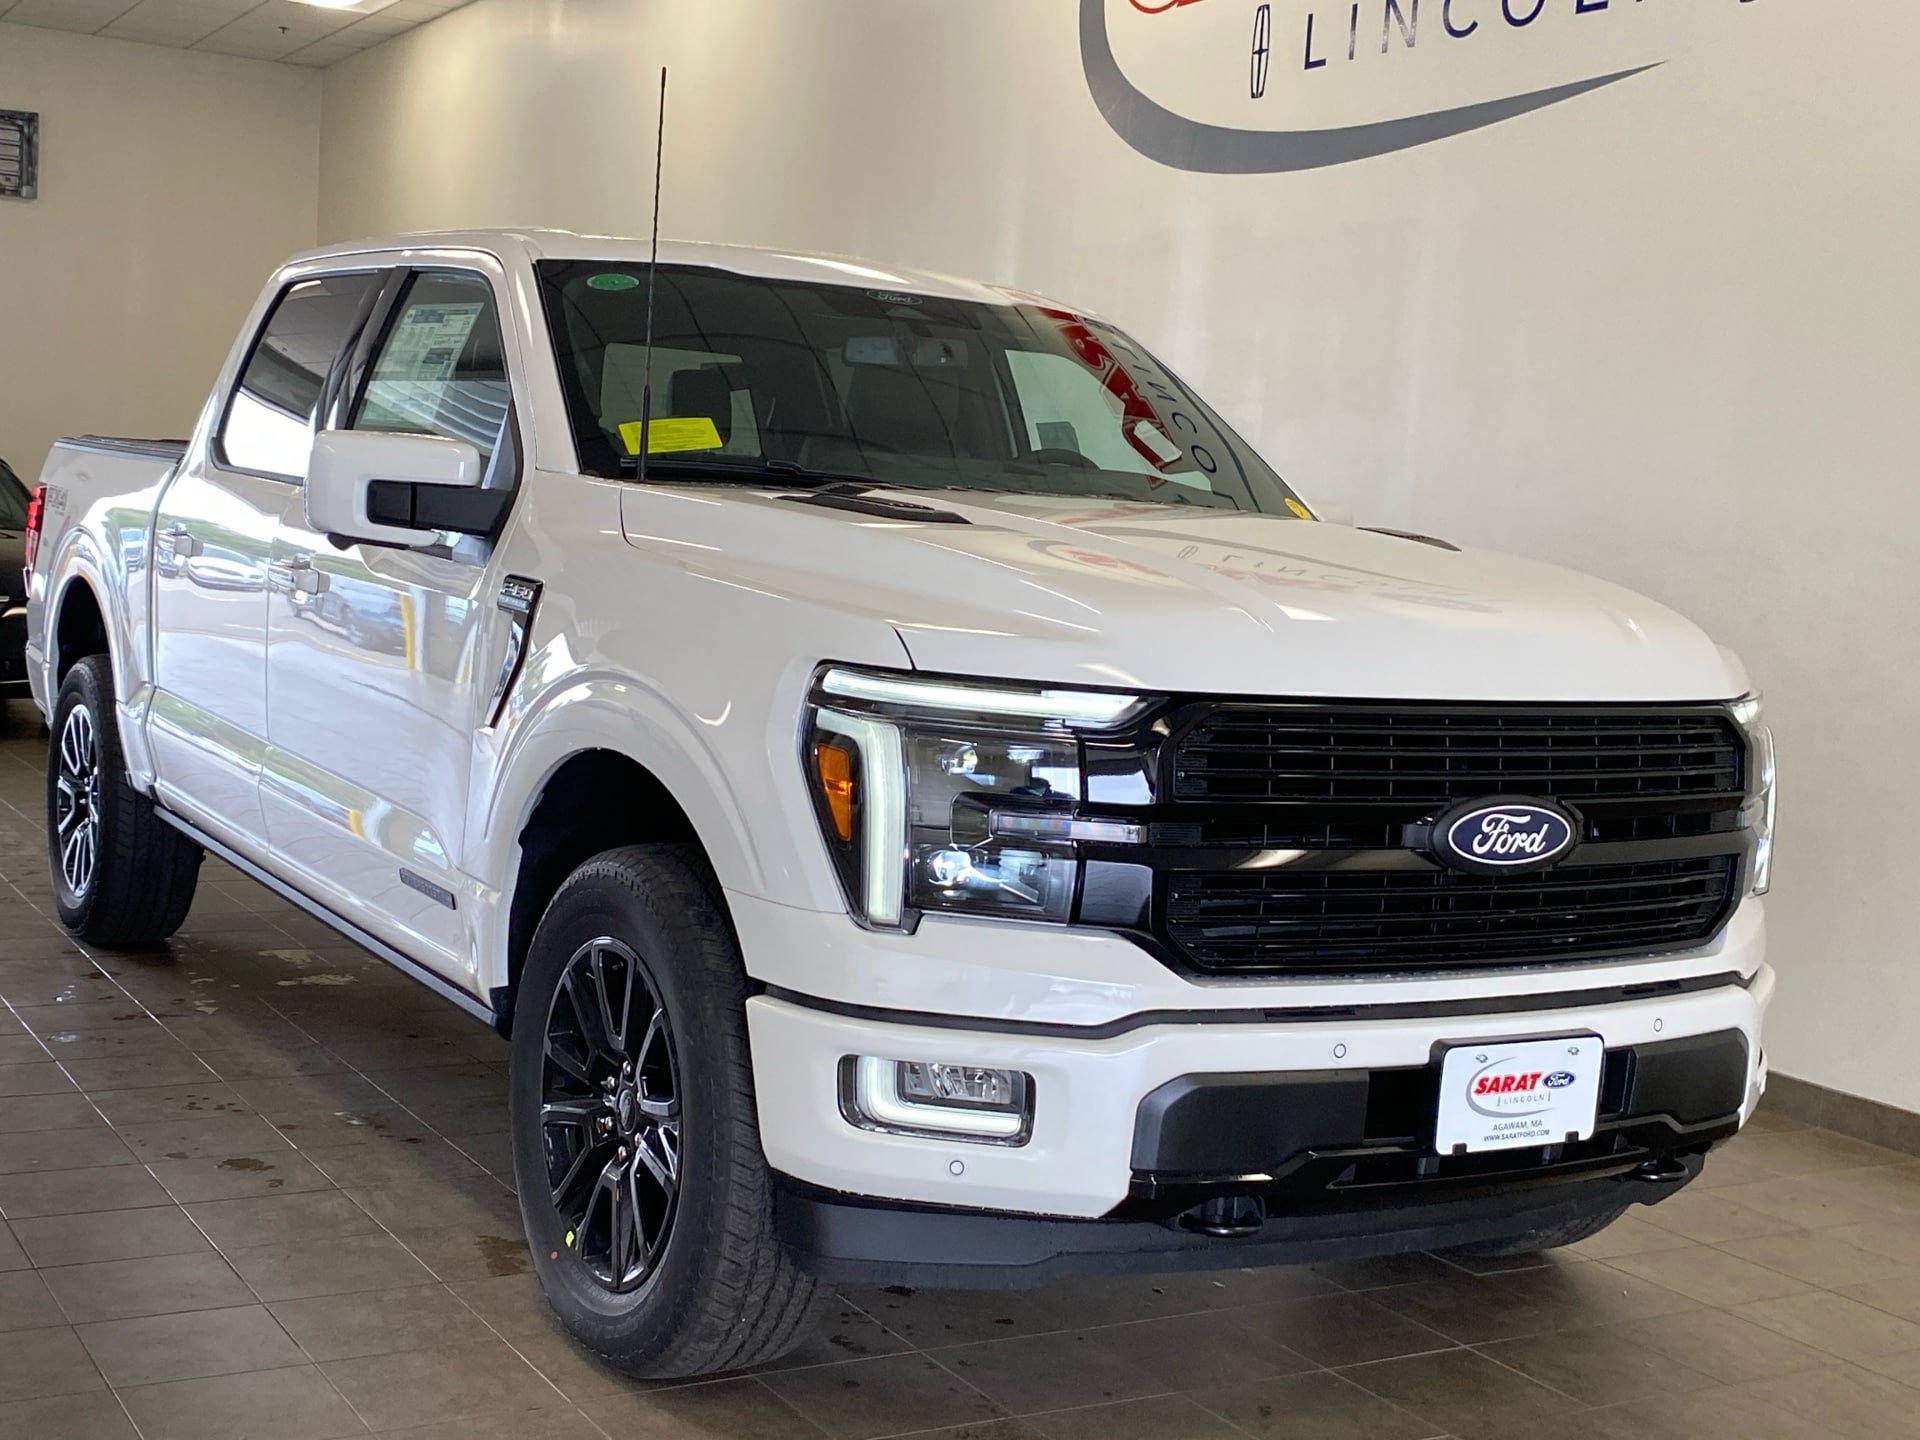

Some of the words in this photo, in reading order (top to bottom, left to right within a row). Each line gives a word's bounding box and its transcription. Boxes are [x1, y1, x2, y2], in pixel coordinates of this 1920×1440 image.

[1304, 0, 1642, 70] LINC
[1472, 813, 1549, 854] Ford
[1474, 1072, 1544, 1094] SARAT
[1546, 1072, 1572, 1087] Ford
[1504, 1093, 1545, 1105] LINCOLN
[1493, 1121, 1529, 1131] AGAWAM,
[1531, 1120, 1543, 1128] MA
[1483, 1129, 1550, 1141] WWW.SARATFORD.COM
